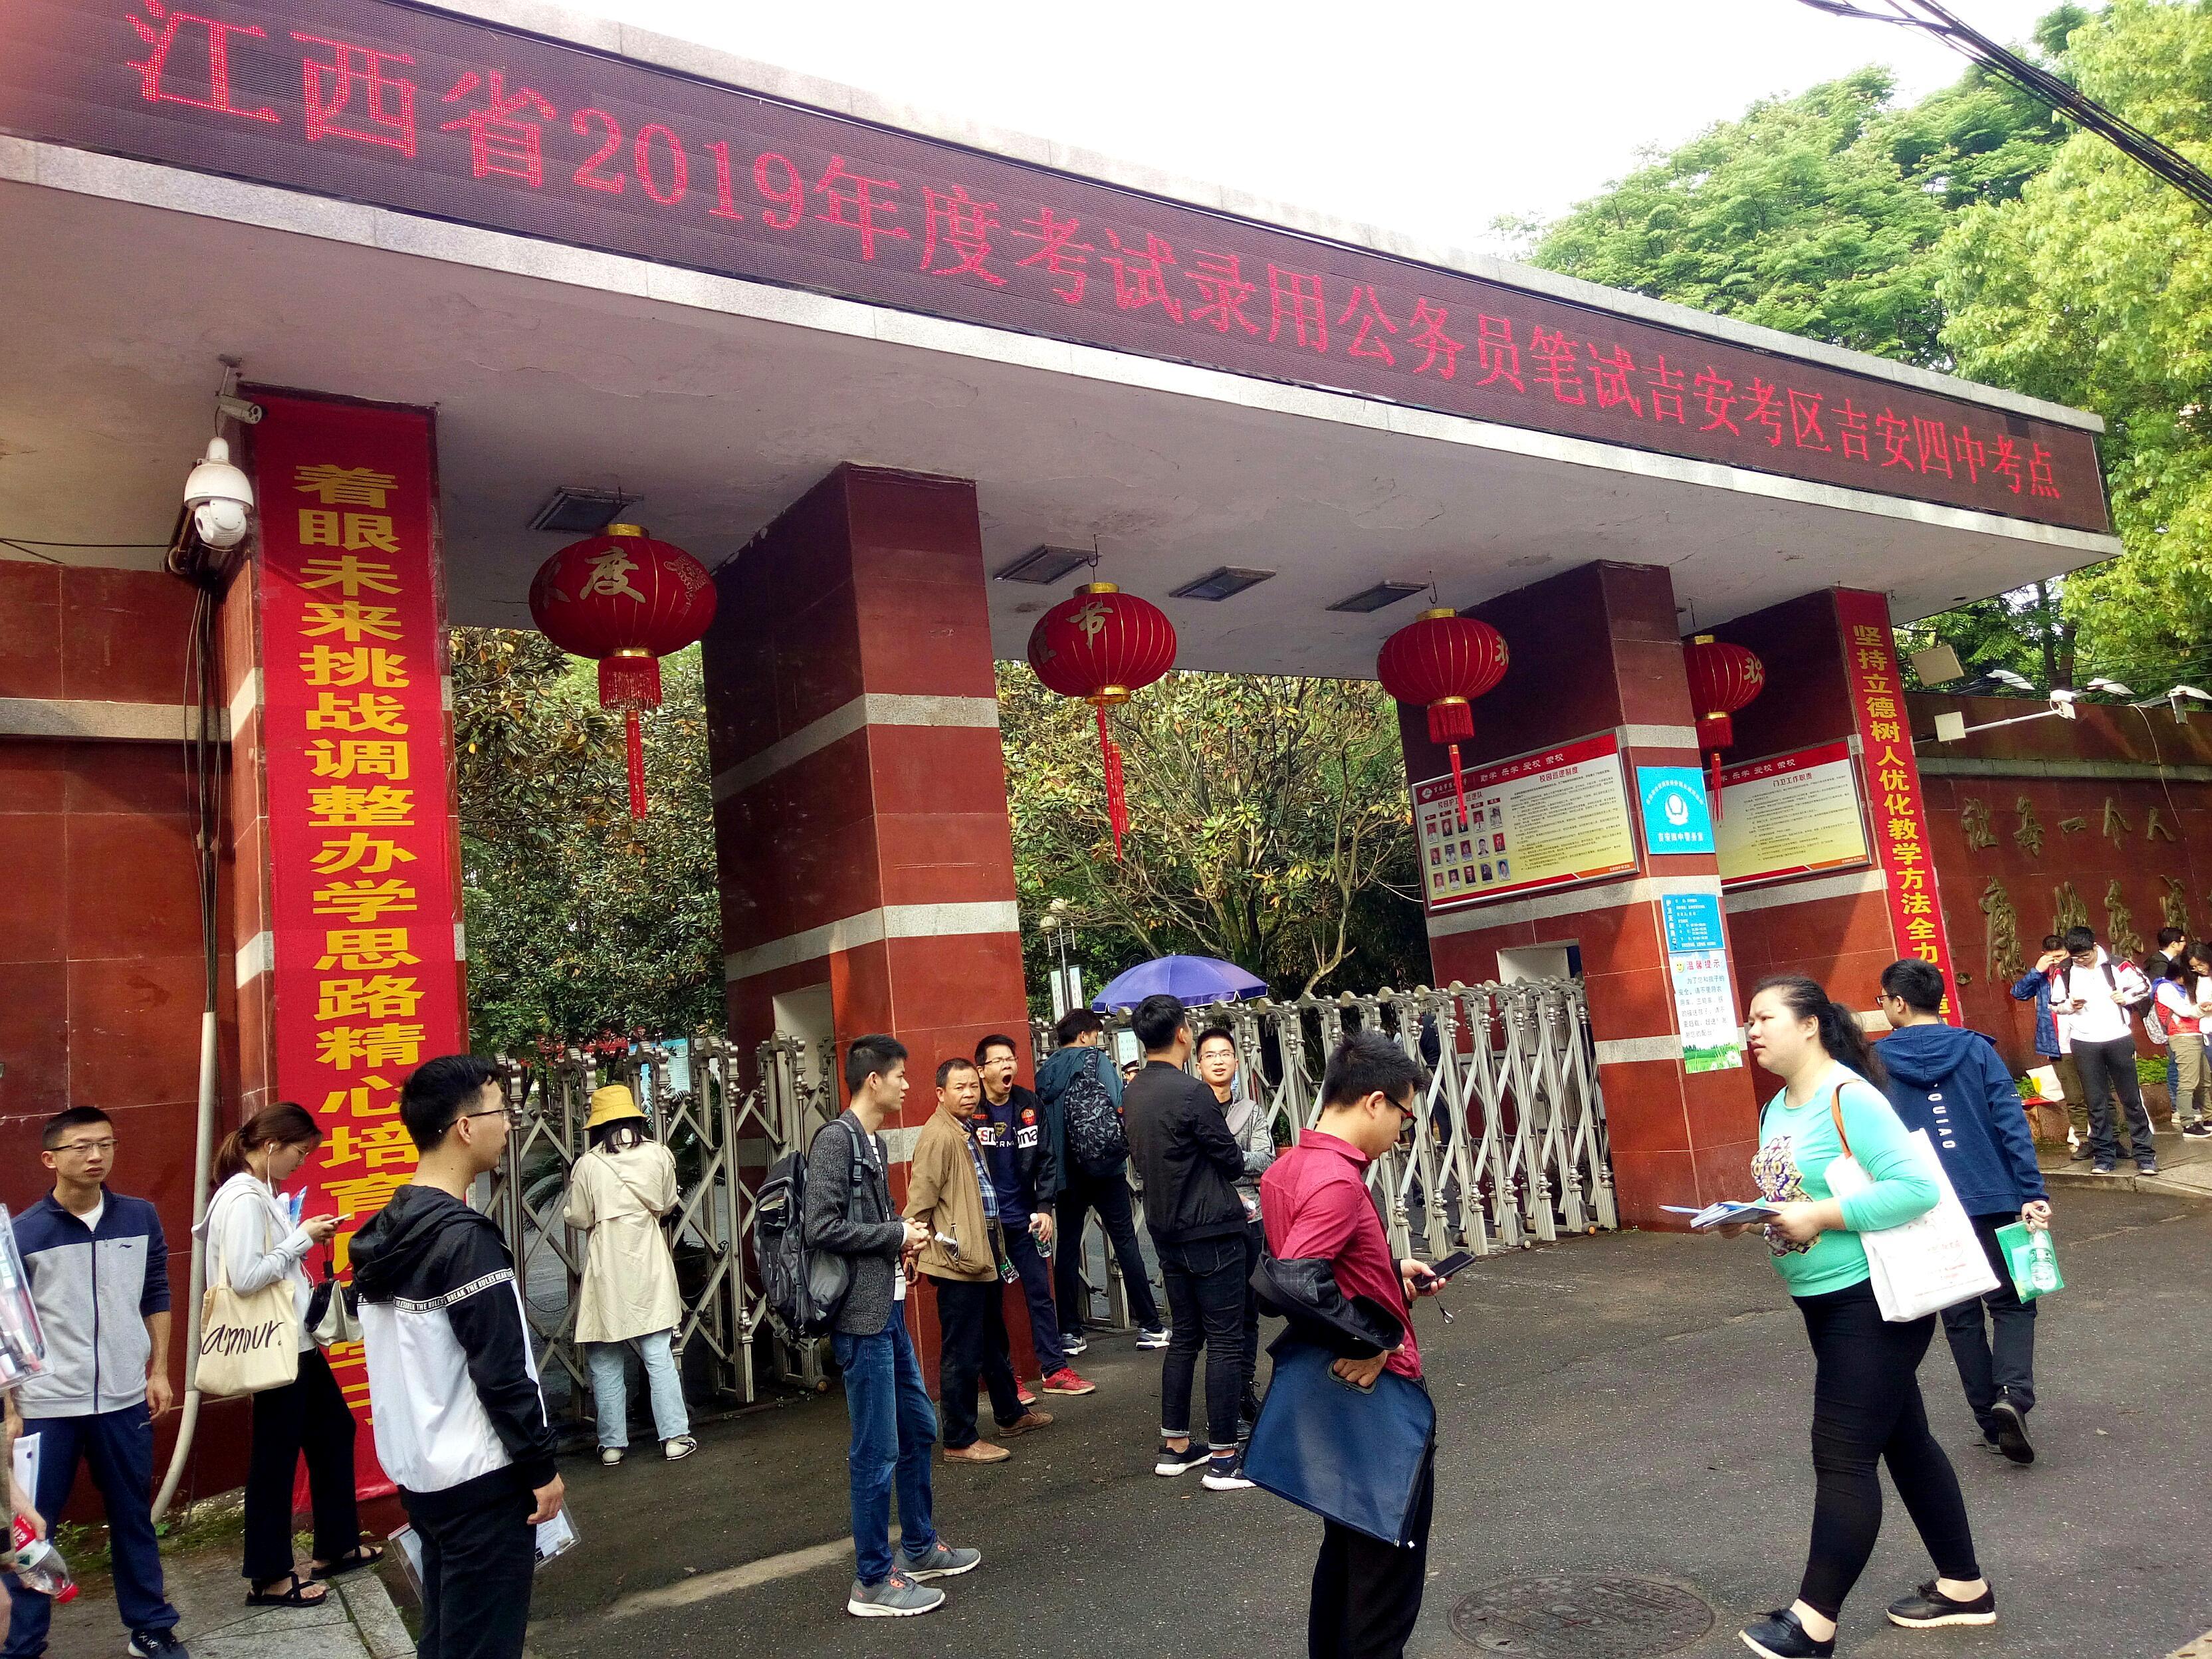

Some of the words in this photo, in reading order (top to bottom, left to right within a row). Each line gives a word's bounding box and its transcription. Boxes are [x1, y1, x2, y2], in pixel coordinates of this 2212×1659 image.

[125, 0, 2062, 499] 江西省2019年度考试录用公务员笔试吉安考区吉安四中考点
[580, 546, 646, 604] 度
[1773, 772, 1813, 787] 门卫工作职责
[293, 463, 426, 1426] 着眼未来挑战调整办学思路精心培育
[1686, 959, 1720, 970] 温馨提示
[1928, 1083, 1956, 1149] QUIAO
[416, 1303, 427, 1311] THE
[447, 1289, 466, 1303] BREAK
[466, 1282, 479, 1293] THE
[478, 1275, 496, 1288] RULES
[201, 1319, 284, 1357] amour.
